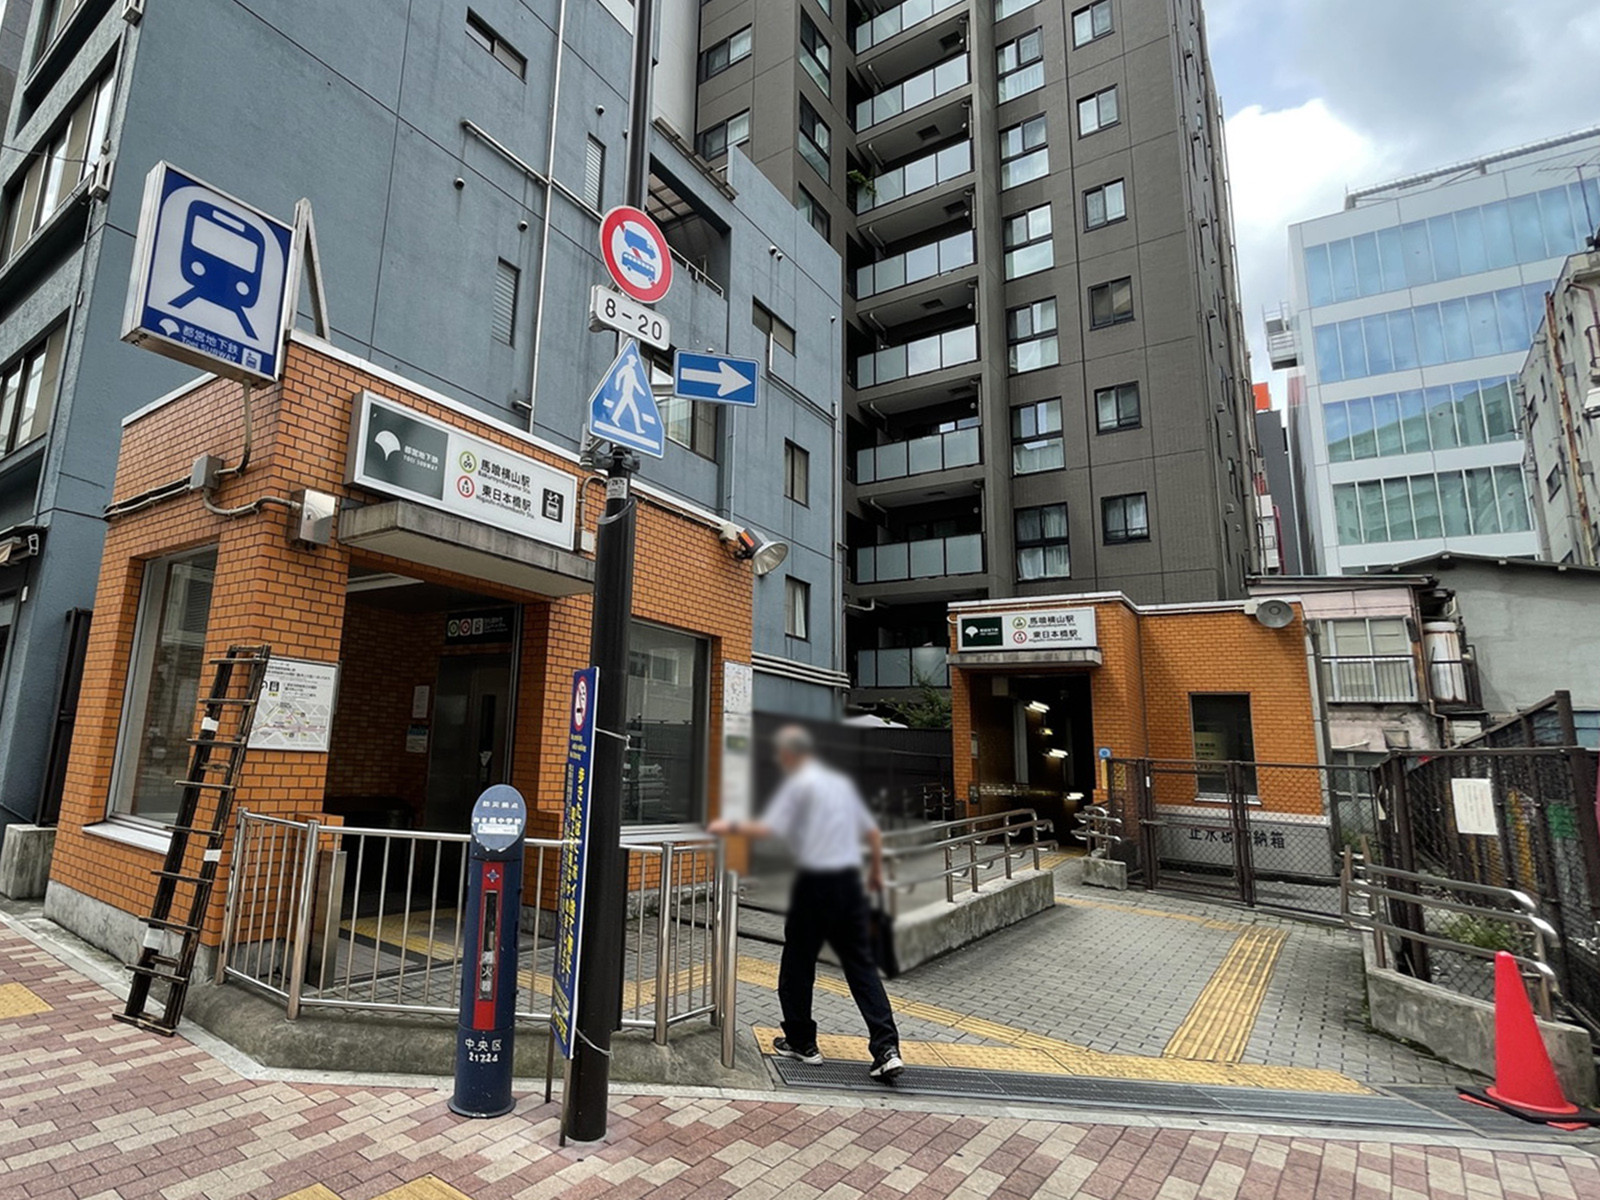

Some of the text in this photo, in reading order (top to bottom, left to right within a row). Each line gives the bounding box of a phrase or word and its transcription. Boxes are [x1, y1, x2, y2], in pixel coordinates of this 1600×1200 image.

[183, 325, 239, 355] 都営地下鉄
[481, 459, 531, 488] 馬喰横山駅
[482, 484, 532, 511] 東日本橋駅
[1029, 614, 1075, 625] 馬喰横山駅
[1033, 629, 1078, 639] 東日本橋駅
[1188, 828, 1285, 849] 止水板納箱
[465, 1038, 502, 1052] 中央区
